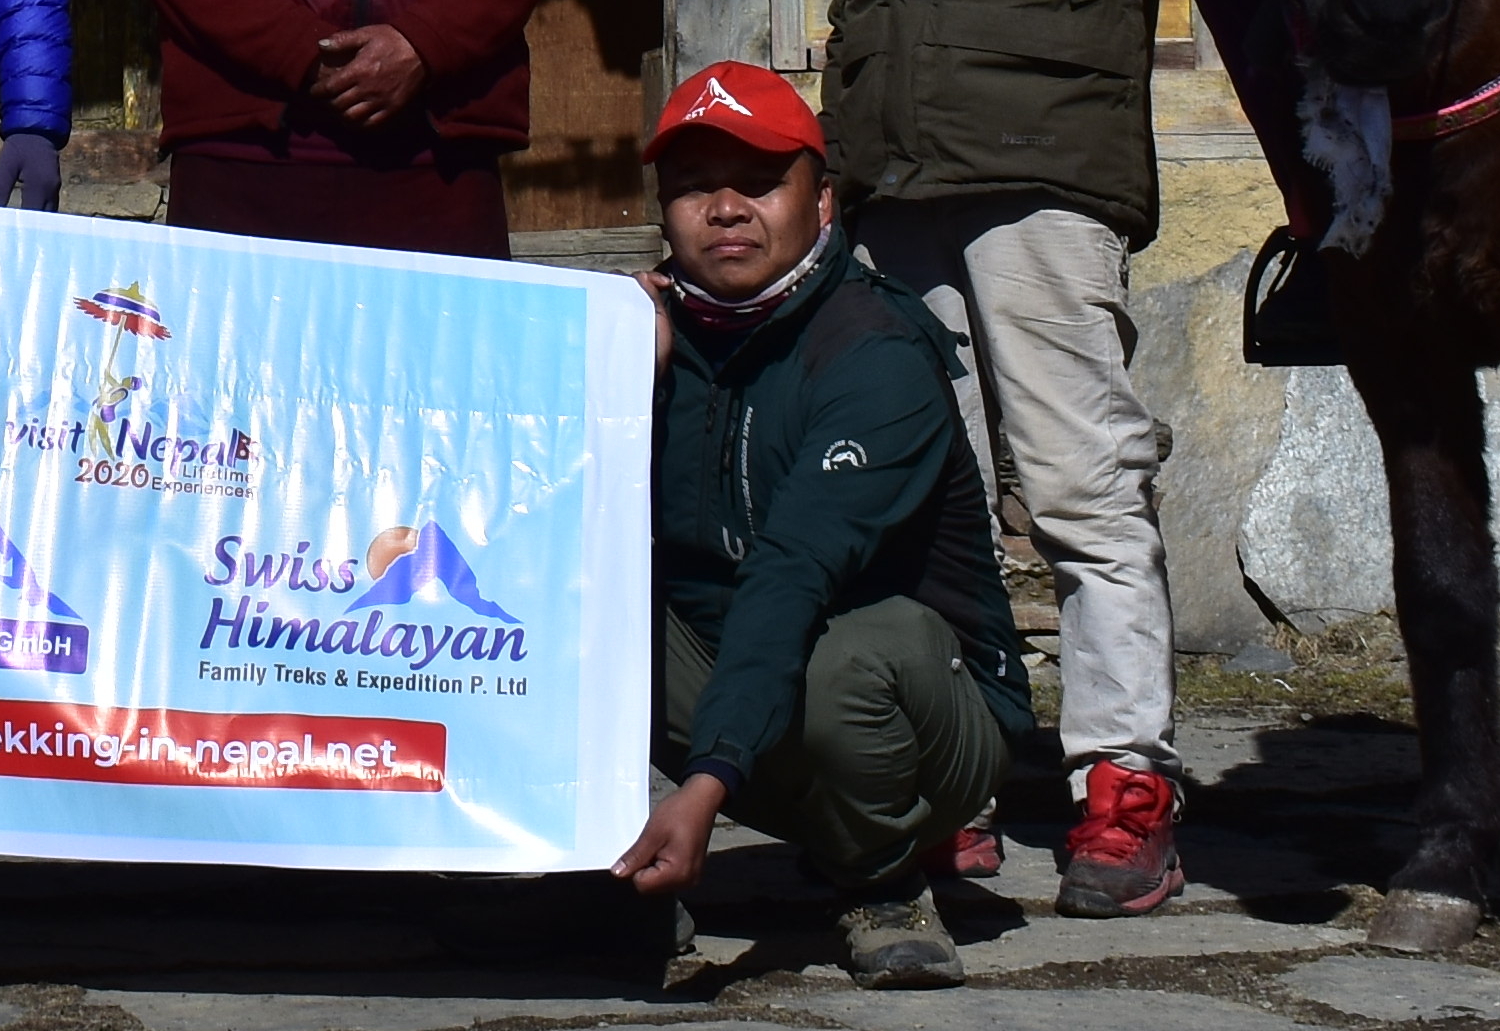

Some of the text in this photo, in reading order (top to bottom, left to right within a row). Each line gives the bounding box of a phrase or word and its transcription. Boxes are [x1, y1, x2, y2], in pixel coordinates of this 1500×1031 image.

[115, 417, 239, 478] Nepal
[74, 457, 150, 488] 2020
[151, 476, 255, 500] Experiences
[182, 464, 256, 484] Lifetime
[203, 535, 359, 594] Swiss
[199, 595, 529, 671] Himalayan
[198, 660, 528, 697] Family Treks & Expedition P. Ltd
